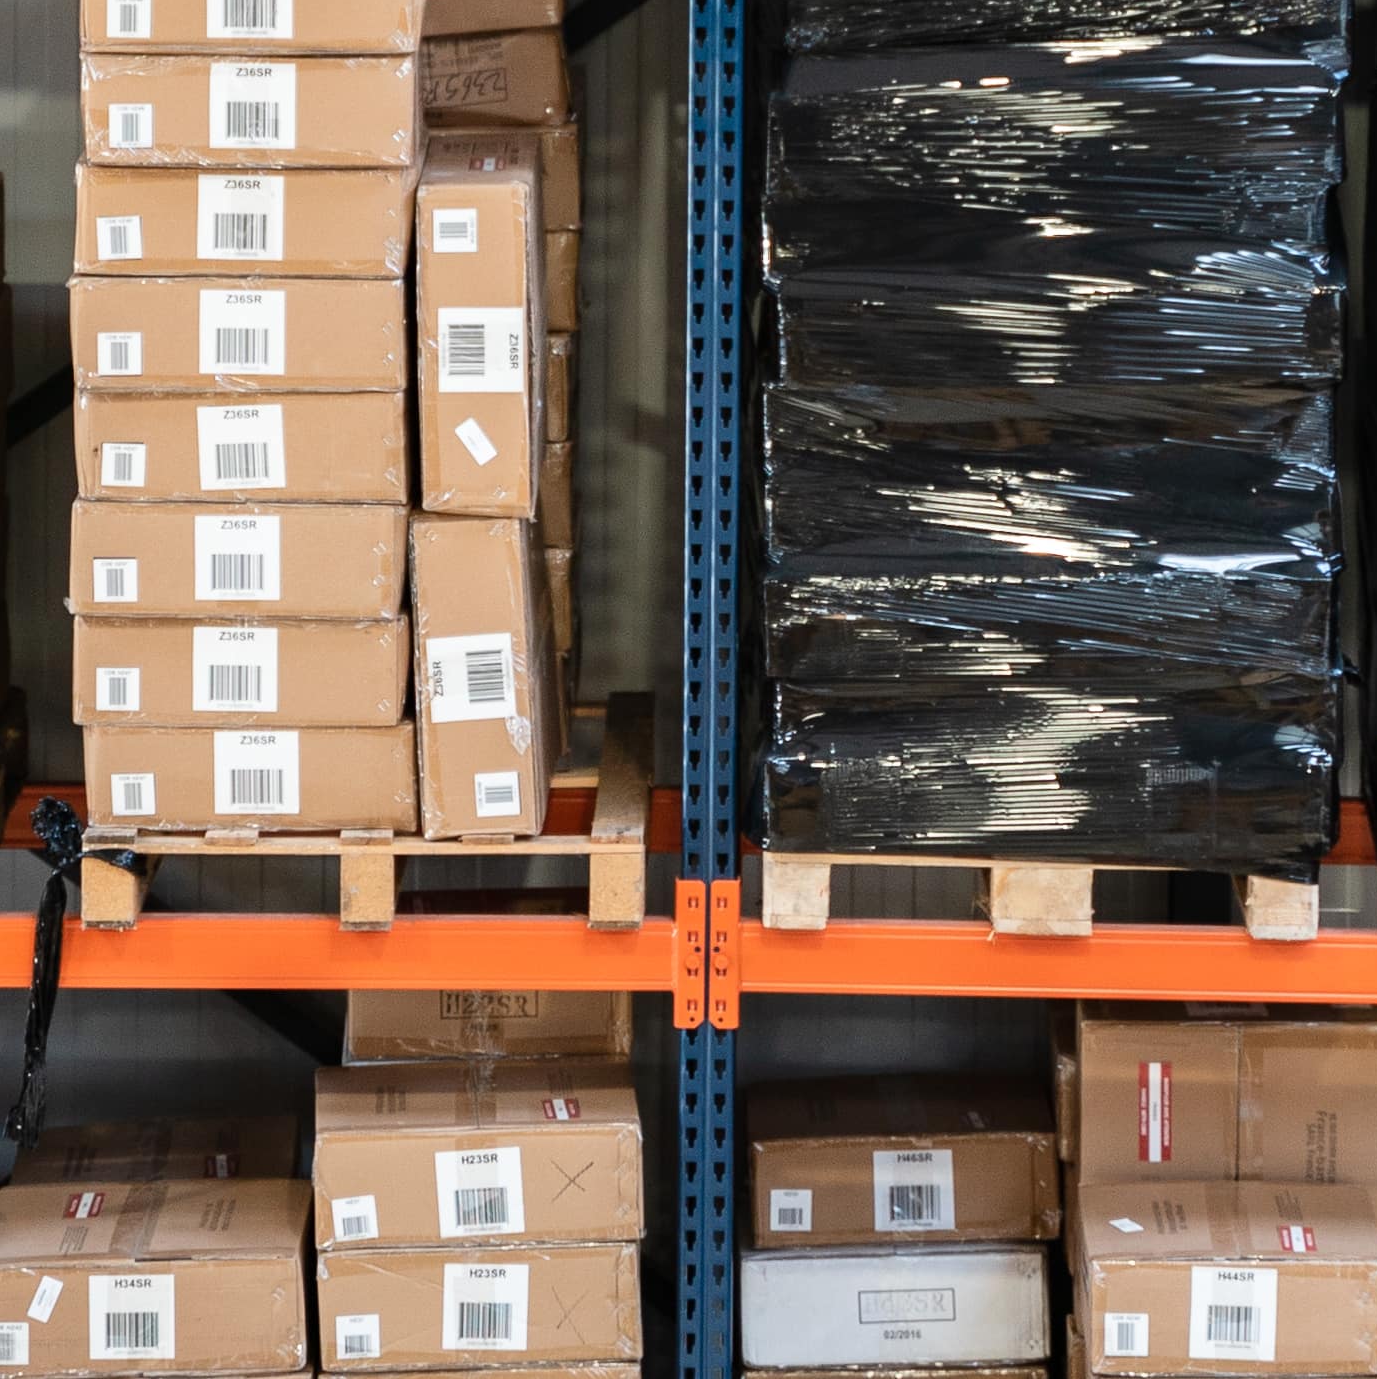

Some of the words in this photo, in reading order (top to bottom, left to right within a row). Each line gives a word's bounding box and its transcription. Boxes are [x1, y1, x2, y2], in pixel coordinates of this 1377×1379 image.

[236, 67, 272, 77] Z36SR
[224, 179, 261, 190] Z36SR
[225, 294, 262, 305] Z36SR
[509, 334, 519, 370] Z36SR
[223, 409, 259, 420] Z36SR
[220, 520, 257, 530] Z36SR
[219, 631, 255, 641] Z36SR
[433, 661, 443, 697] Z36SR
[240, 735, 276, 746] Z36SR
[461, 1154, 499, 1165] H23SR
[469, 1268, 506, 1279] H23SR
[1217, 1272, 1255, 1282] H44SR
[114, 1279, 152, 1288] H34SR
[884, 1330, 922, 1340] 02/2016
